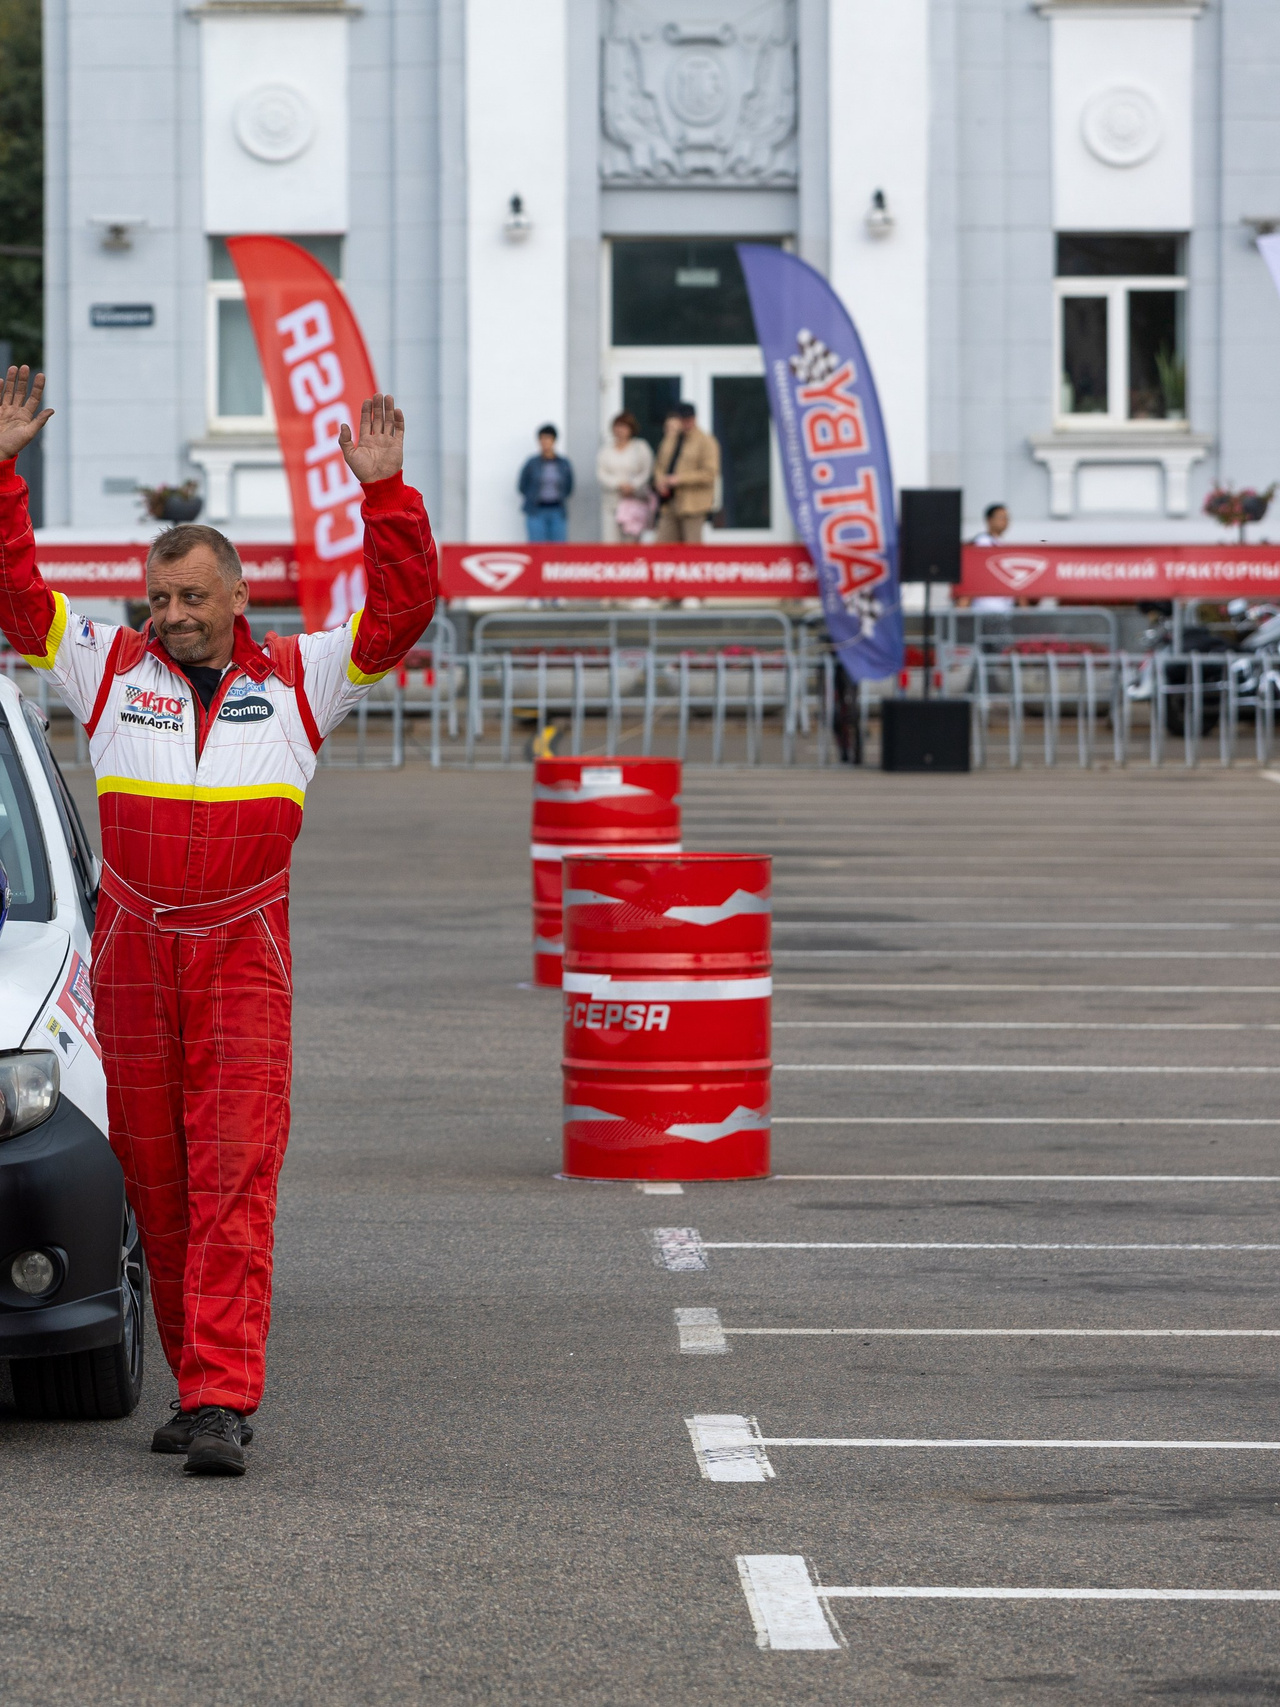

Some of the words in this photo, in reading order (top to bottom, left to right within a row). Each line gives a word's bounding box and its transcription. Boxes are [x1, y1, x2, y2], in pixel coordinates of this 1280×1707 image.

[542, 558, 648, 582] МИНСКИЙ
[652, 557, 793, 582] ТРАКТОРНЫЙ
[1056, 558, 1155, 580] МИНСКИЙ
[1164, 561, 1280, 580] ТРАКТОРНЫ
[221, 705, 269, 717] Comma
[573, 1002, 671, 1031] CEPSA
